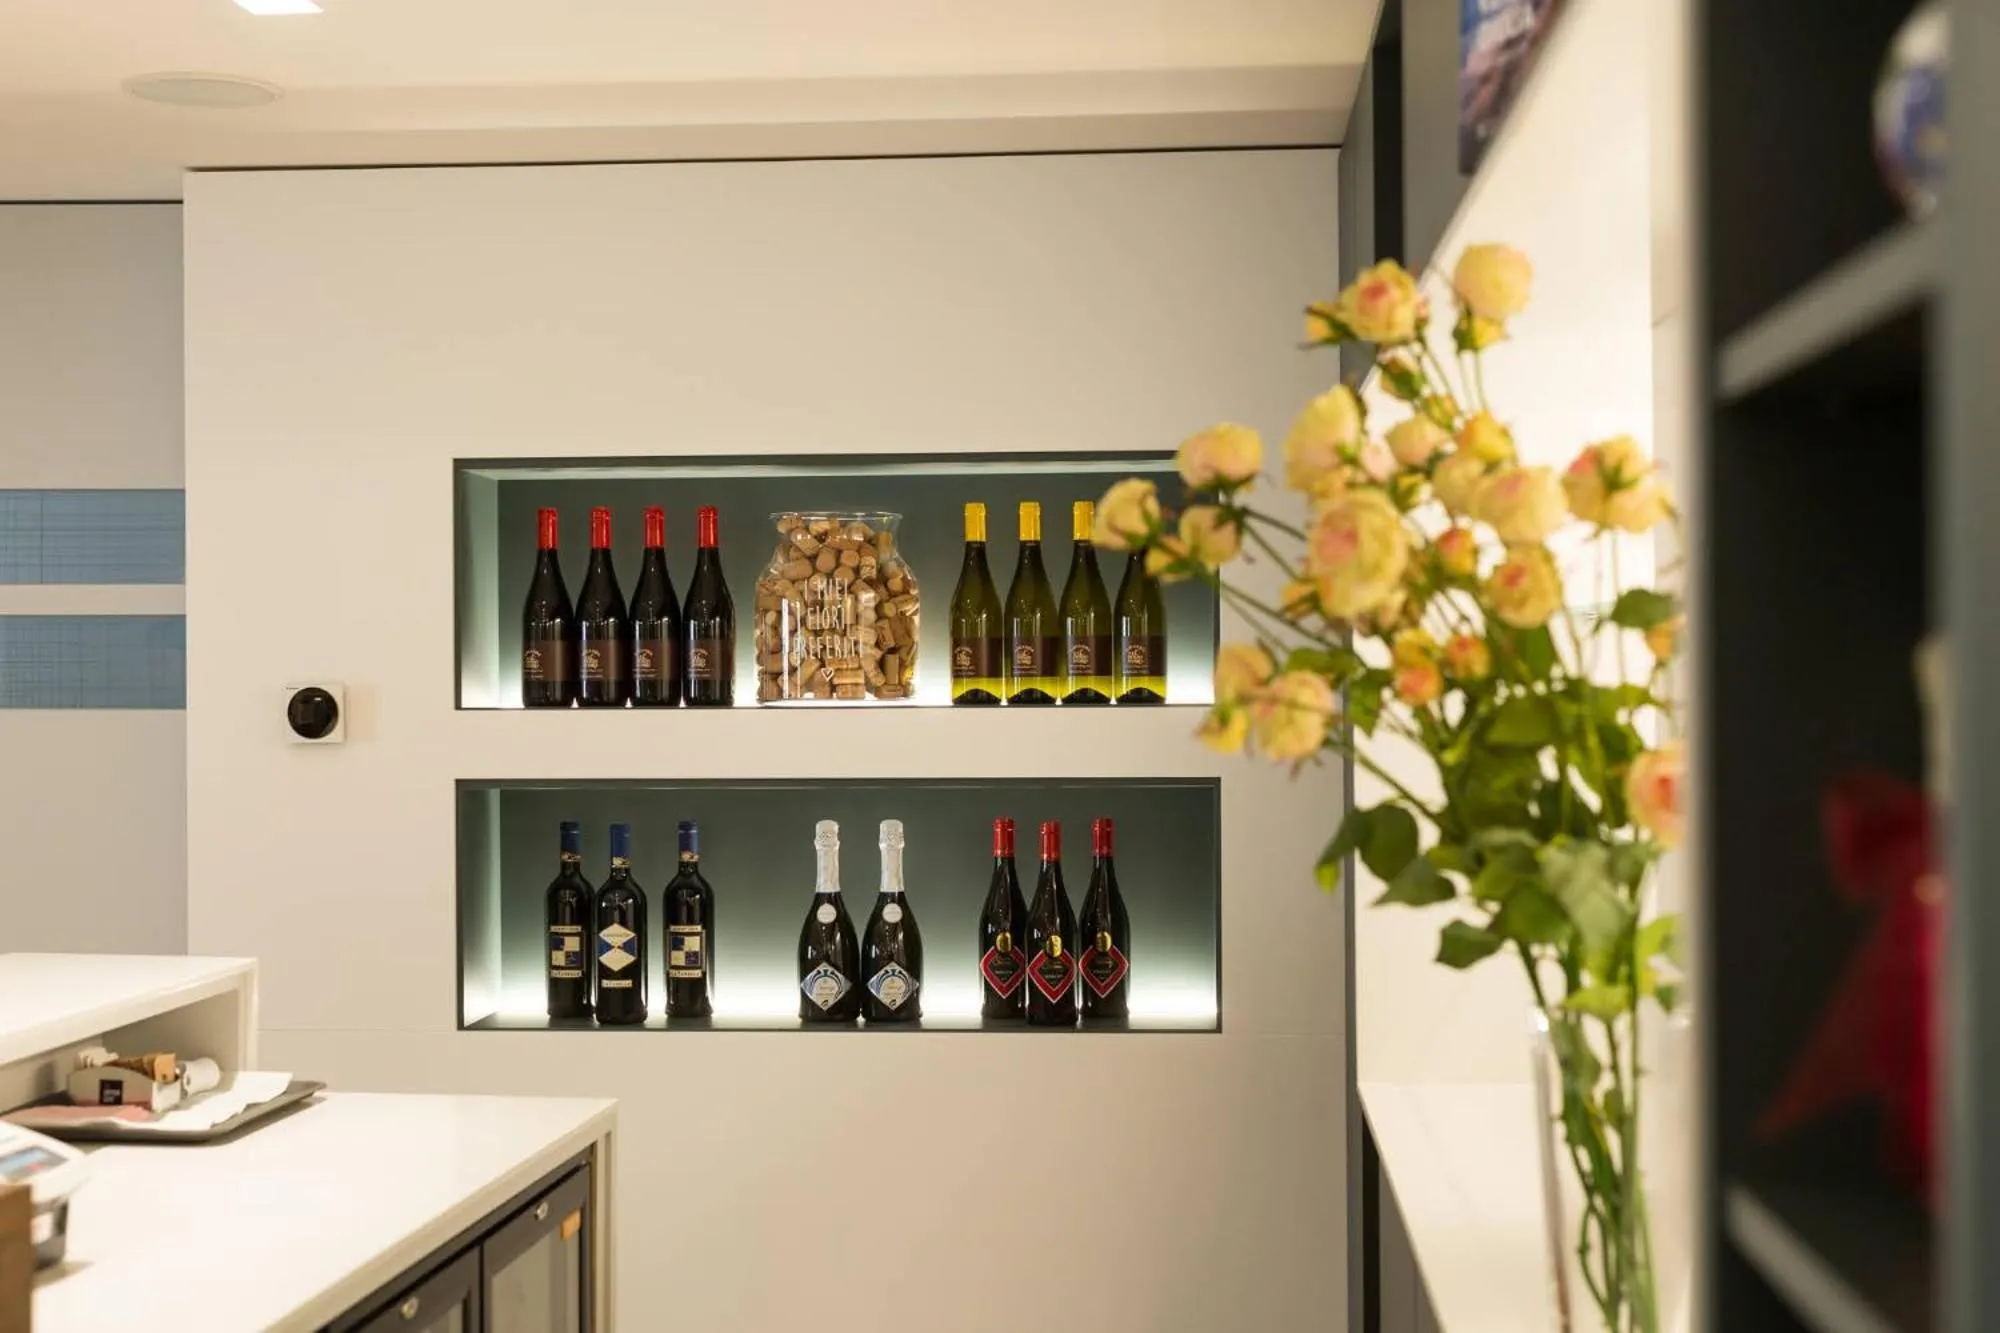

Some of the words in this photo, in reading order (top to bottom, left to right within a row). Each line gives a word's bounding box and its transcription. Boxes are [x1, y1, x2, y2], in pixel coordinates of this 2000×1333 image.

[817, 578, 848, 602] MIEI
[807, 605, 845, 630] FIORI
[793, 633, 864, 660] PREFERITI
